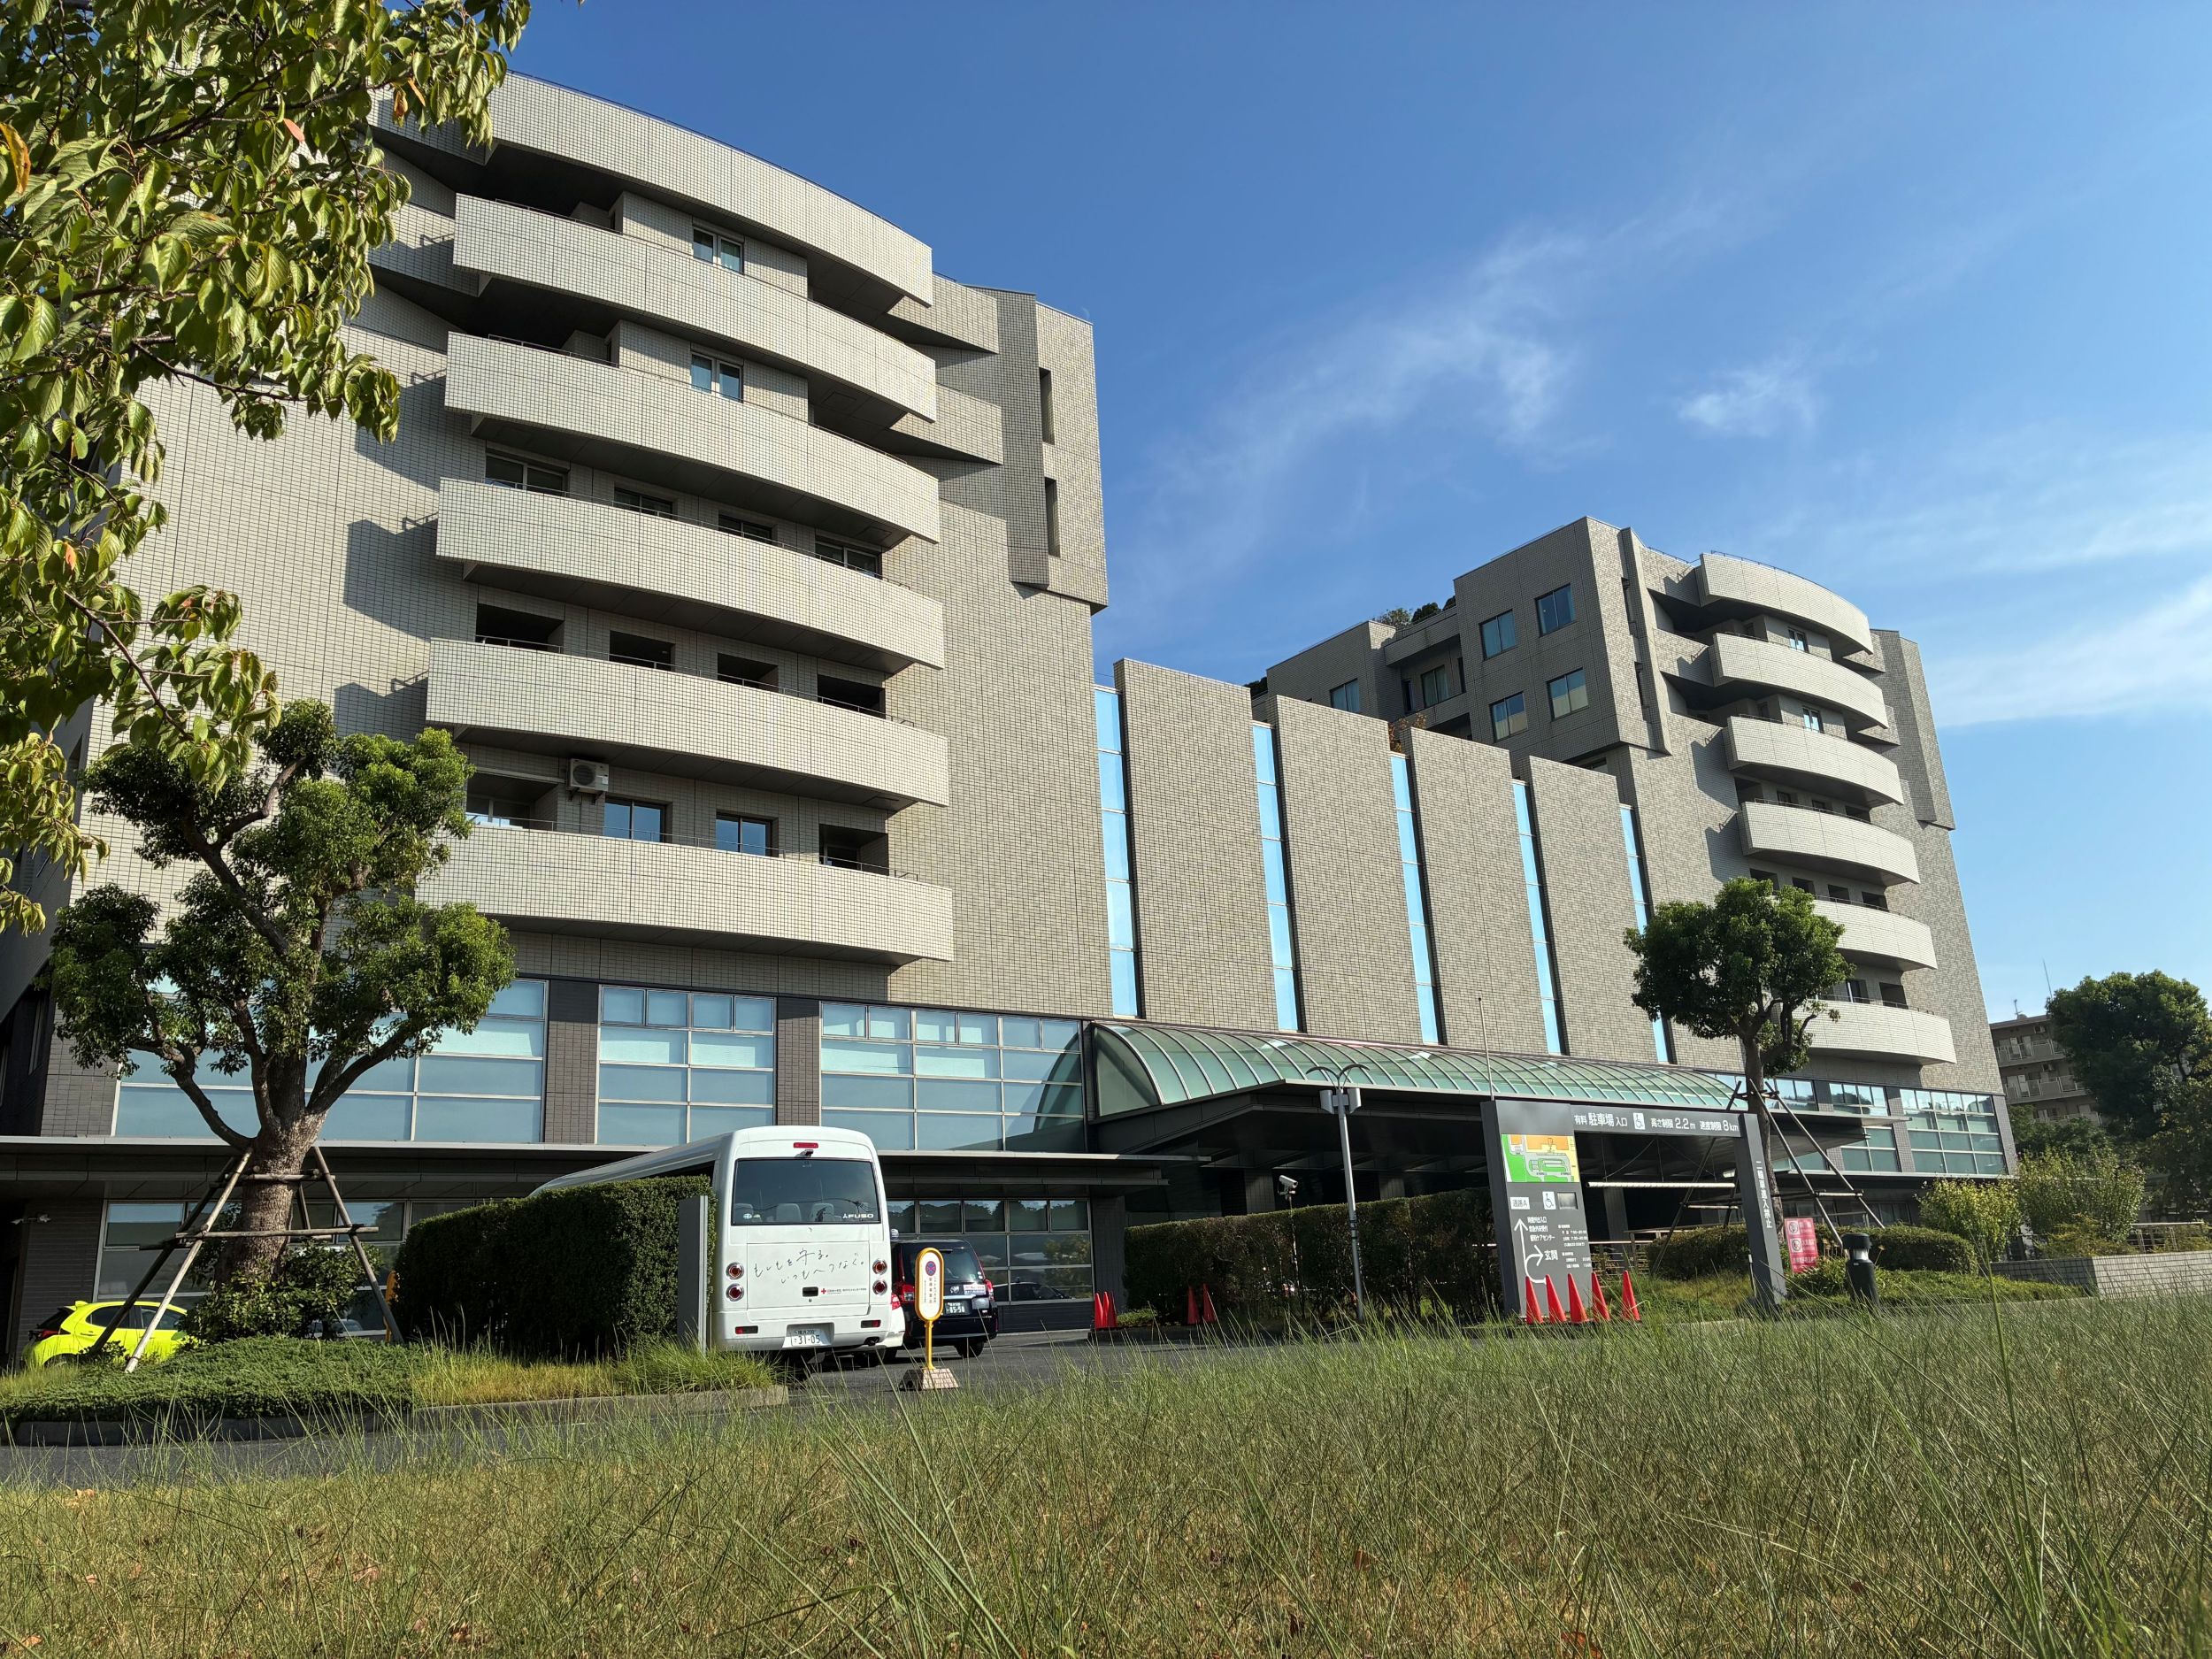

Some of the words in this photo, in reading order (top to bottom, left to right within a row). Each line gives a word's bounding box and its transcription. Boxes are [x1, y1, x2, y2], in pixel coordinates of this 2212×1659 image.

[1574, 1112, 1628, 1127] 有料駐車場入口
[1512, 1199, 1528, 1208] 通路A
[1544, 1249, 1558, 1260] 玄関
[798, 1334, 821, 1345] 31-05
